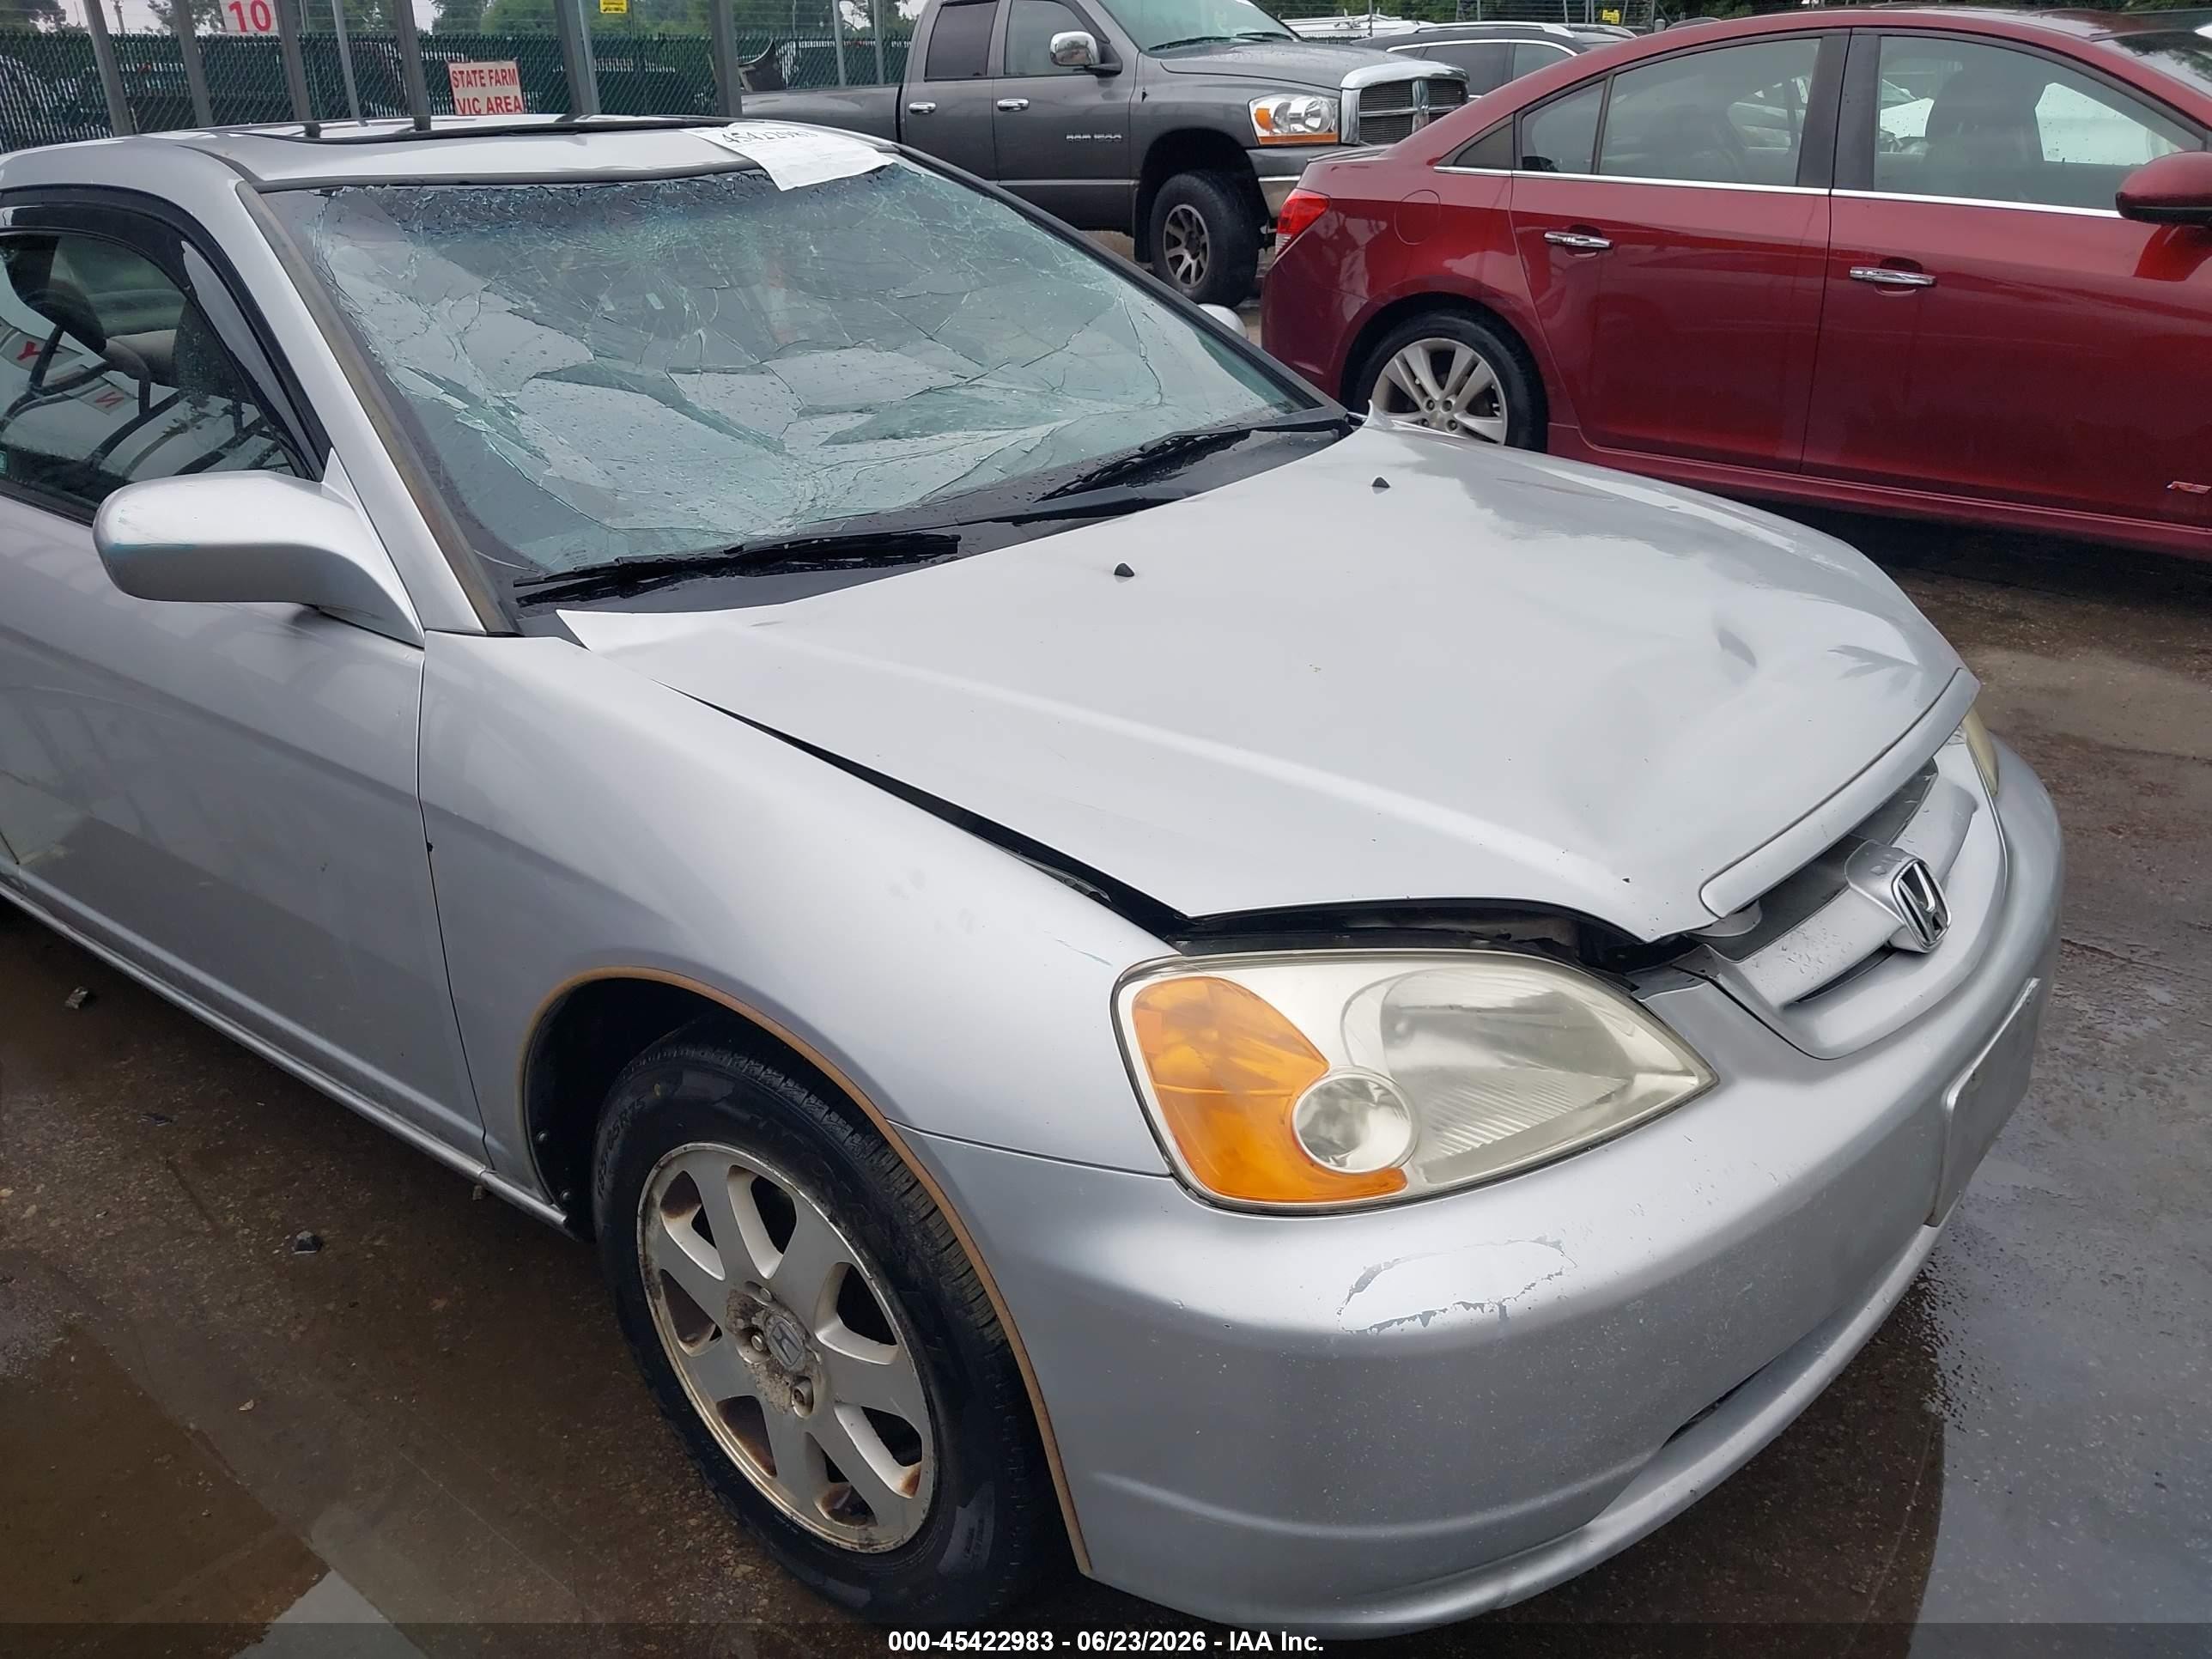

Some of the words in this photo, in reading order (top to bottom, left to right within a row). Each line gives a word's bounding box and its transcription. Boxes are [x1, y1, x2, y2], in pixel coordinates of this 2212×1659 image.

[228, 0, 271, 32] 10
[452, 70, 486, 88] STATE
[488, 68, 518, 86] FARM
[457, 97, 482, 114] VIC
[486, 95, 523, 114] AREA
